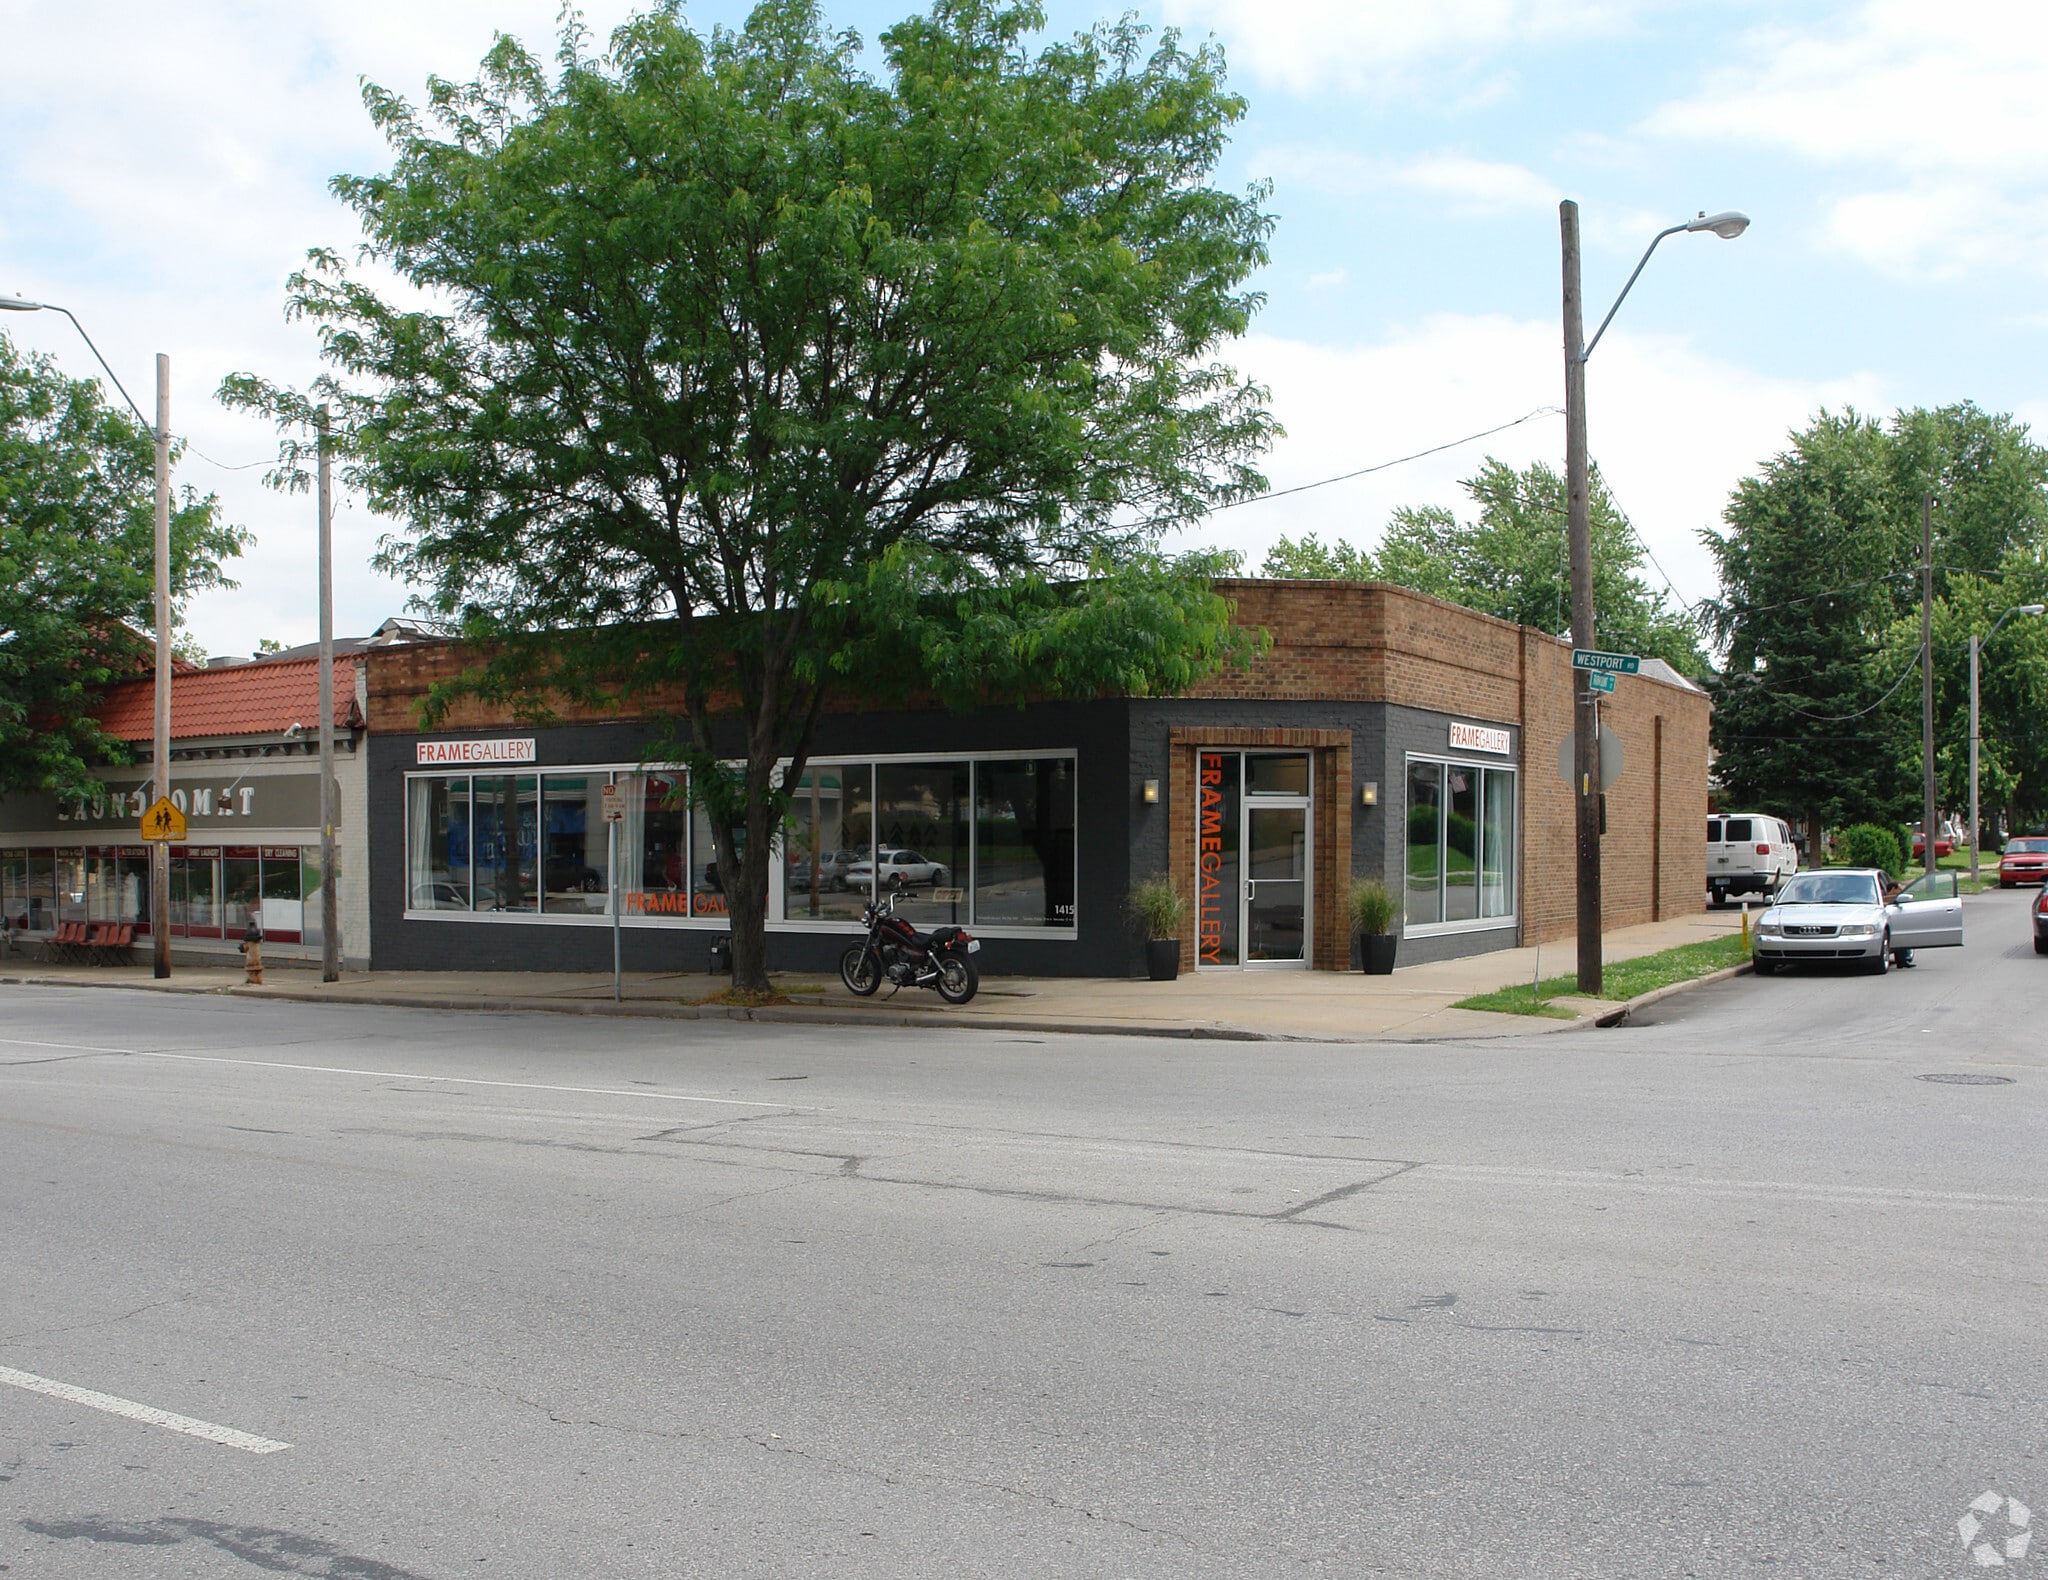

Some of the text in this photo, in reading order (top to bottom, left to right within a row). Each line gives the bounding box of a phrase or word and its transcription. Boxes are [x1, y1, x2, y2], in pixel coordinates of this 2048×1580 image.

[1577, 653, 1624, 670] WESTPORT
[1451, 725, 1509, 752] FRAMEGALLERY
[419, 741, 533, 761] FRAMEGALLERY
[1200, 754, 1222, 965] FRAMEGALLERY
[1055, 905, 1075, 915] 1415
